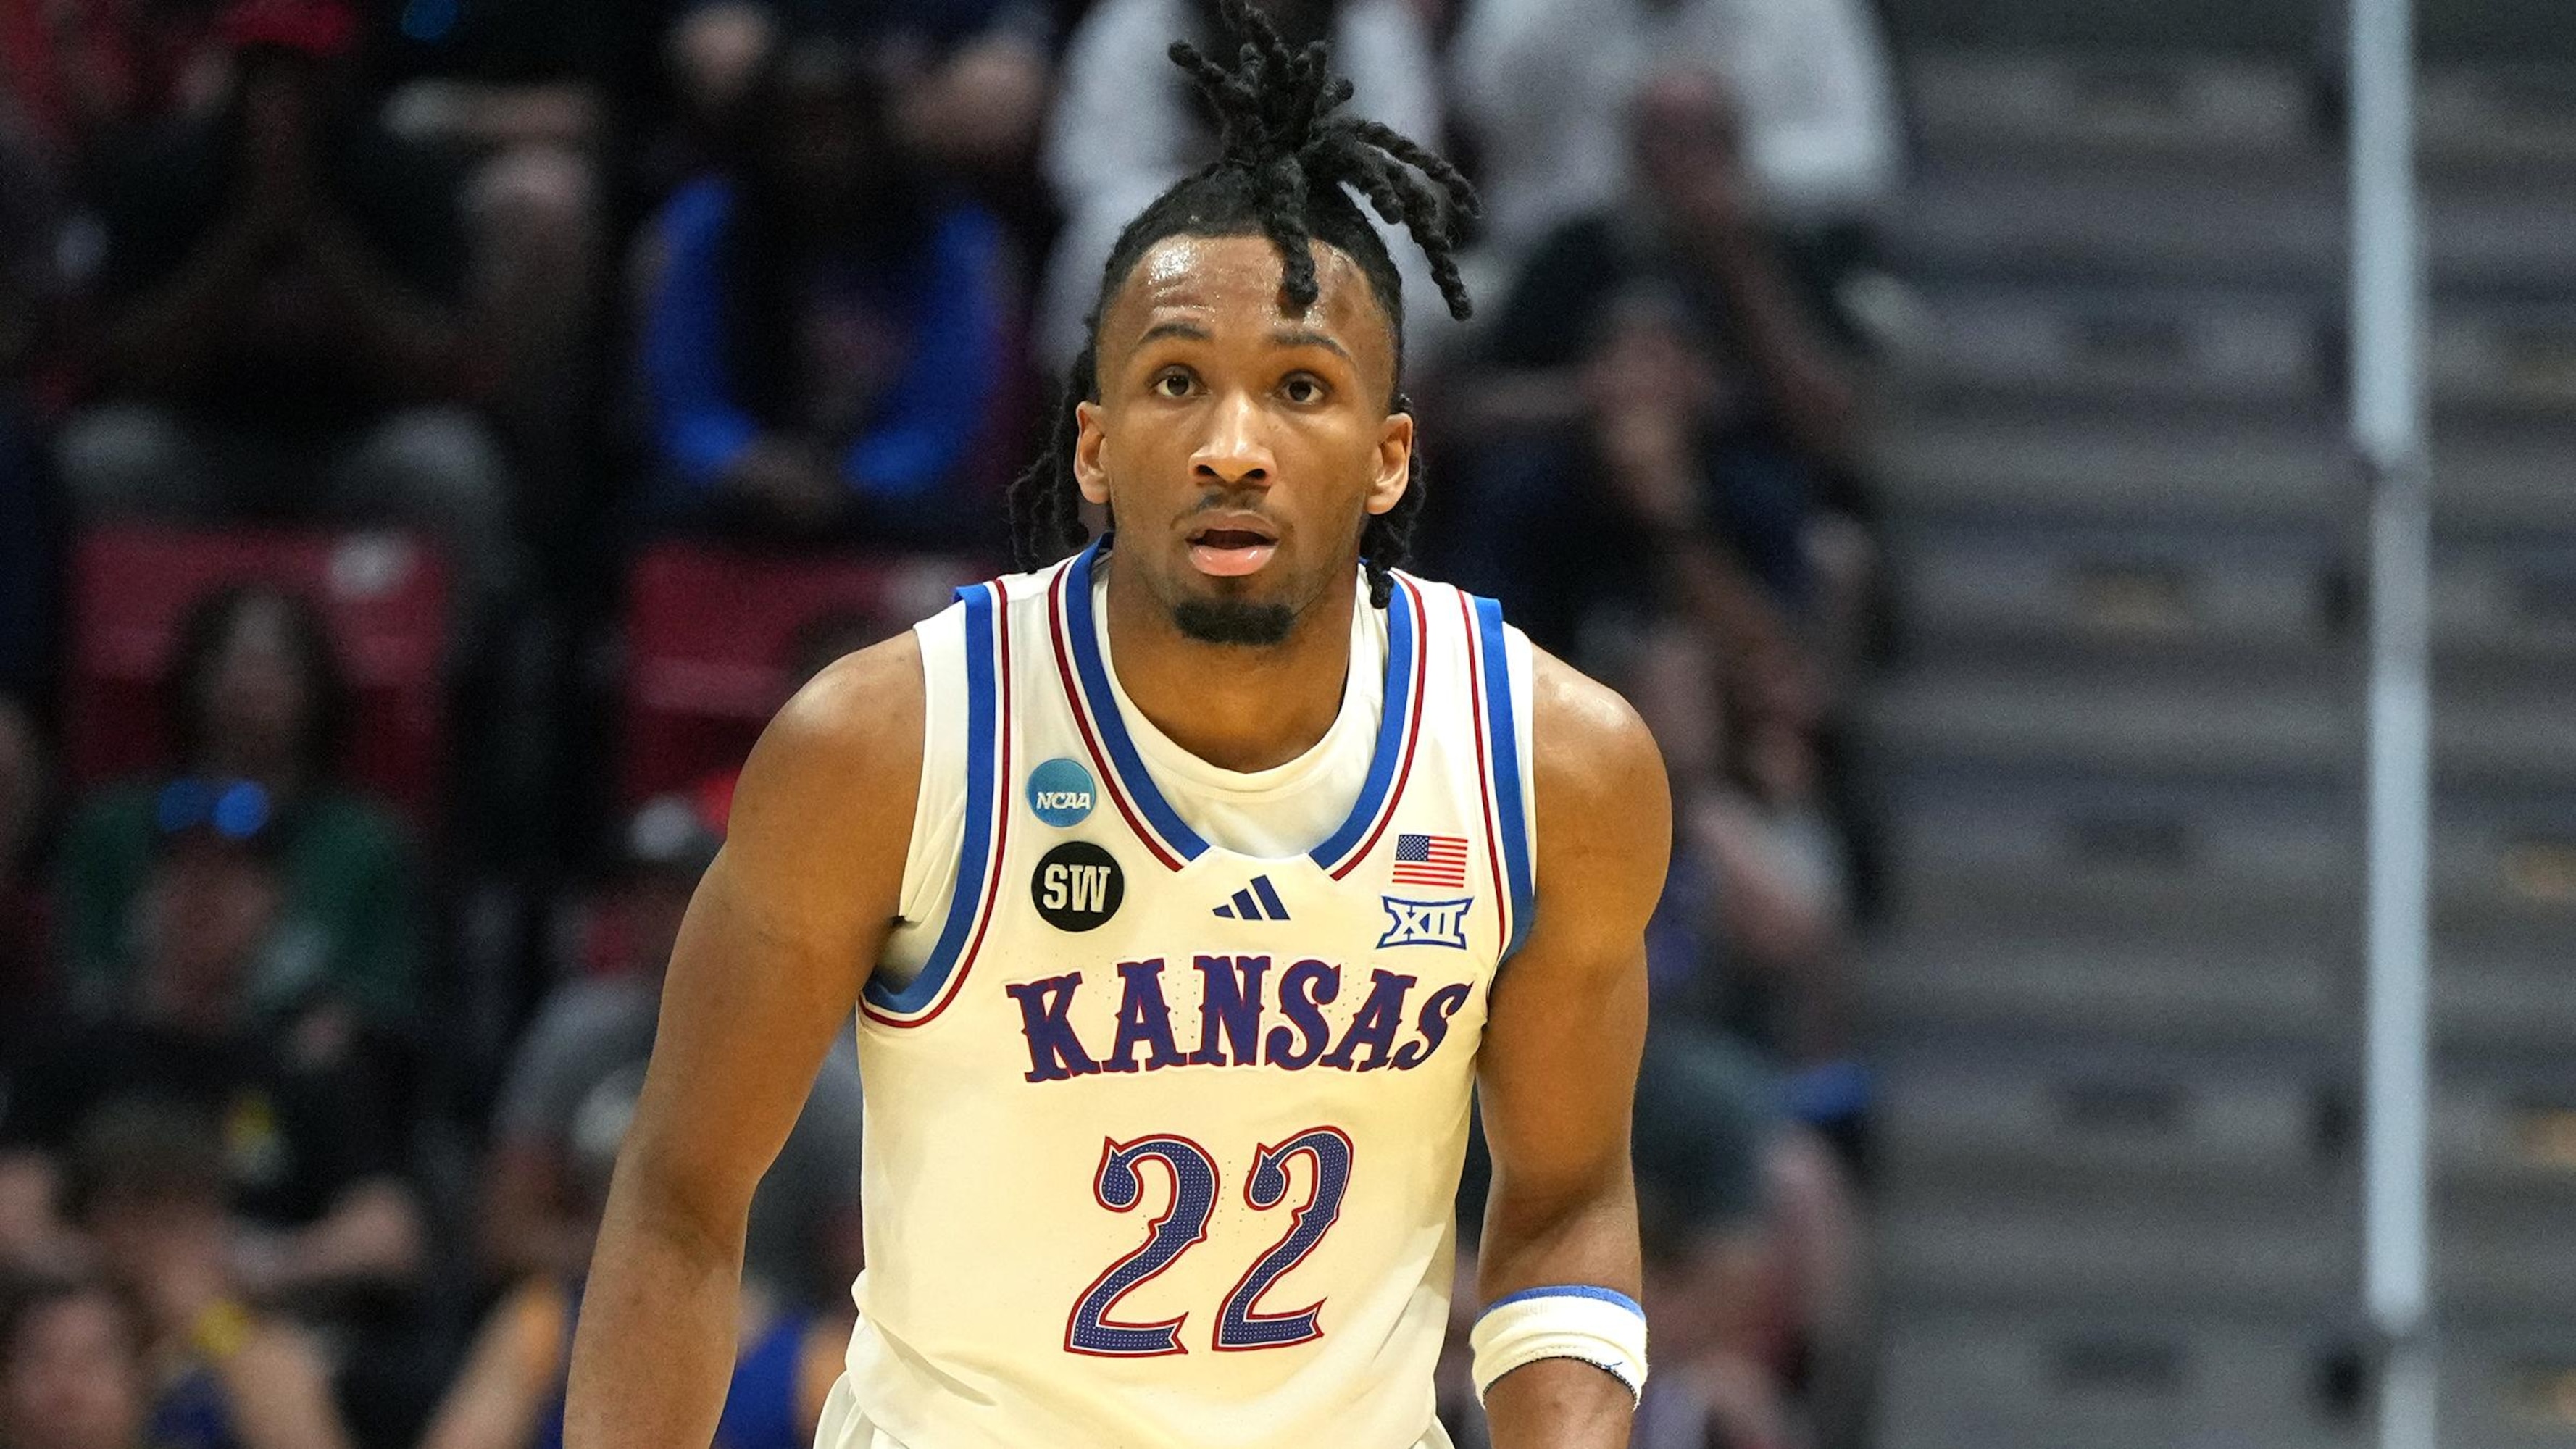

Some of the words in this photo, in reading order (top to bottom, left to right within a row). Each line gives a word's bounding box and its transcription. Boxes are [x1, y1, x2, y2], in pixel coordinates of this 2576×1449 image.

[1035, 791, 1091, 810] NCAA
[1043, 863, 1112, 913] SW
[1375, 895, 1475, 950] XII
[1005, 954, 1474, 1084] KANSAS
[1063, 1124, 1354, 1358] 22
